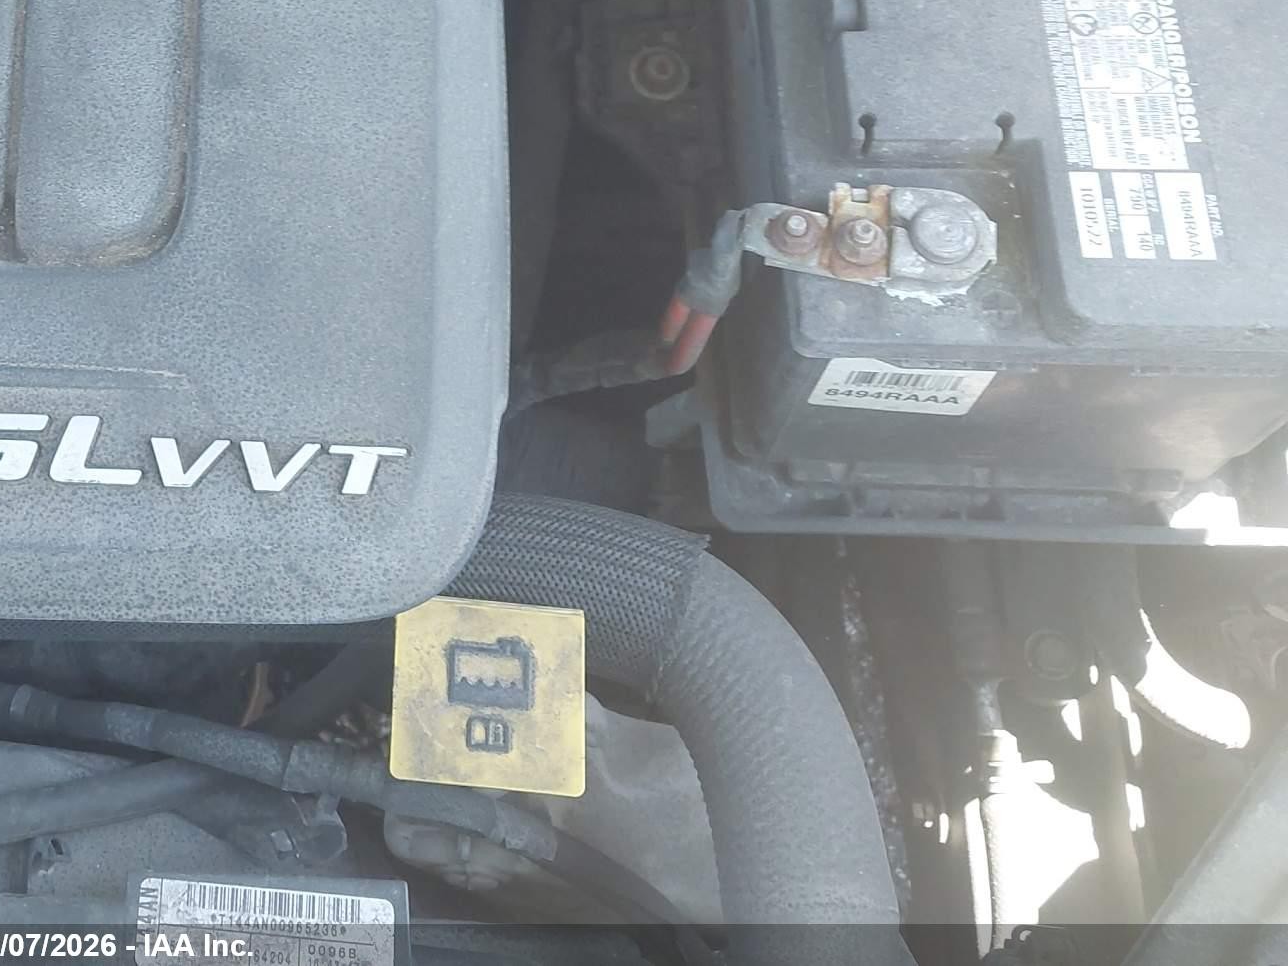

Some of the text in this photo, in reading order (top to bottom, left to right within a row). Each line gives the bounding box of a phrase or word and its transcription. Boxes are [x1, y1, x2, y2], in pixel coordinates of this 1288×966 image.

[1205, 194, 1221, 220] PART
[1136, 231, 1154, 252] 140
[825, 387, 960, 405] 8494RAAA
[150, 436, 409, 496] VVT
